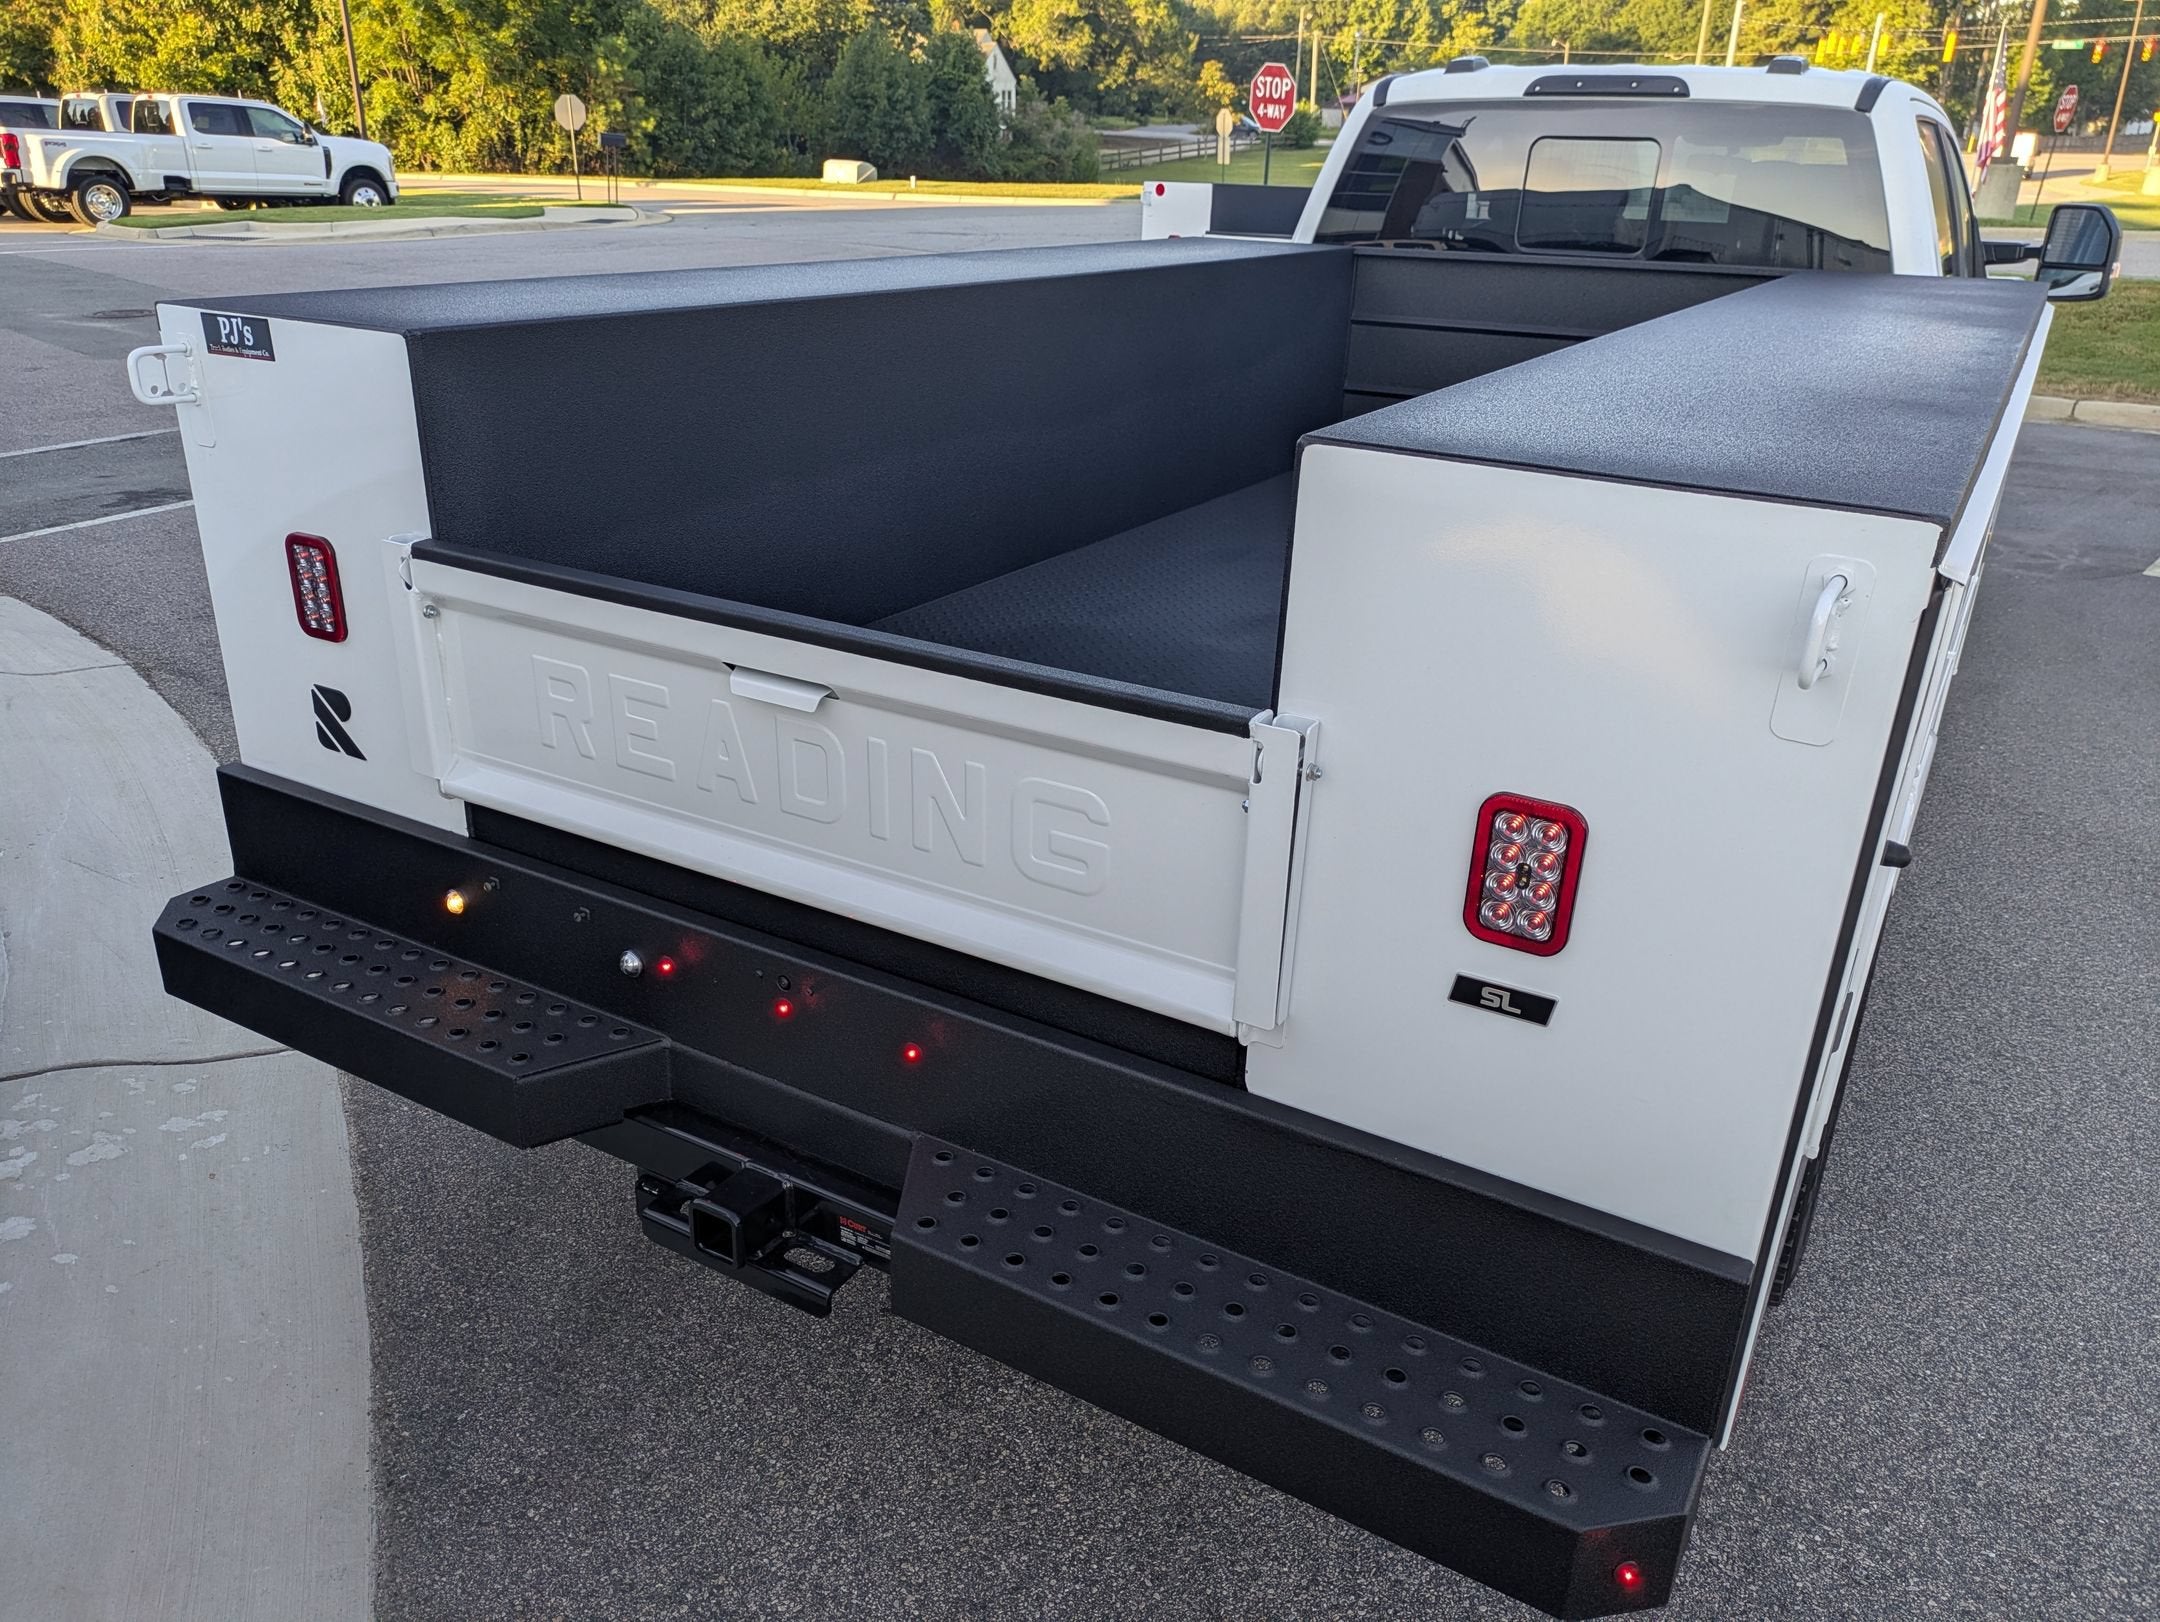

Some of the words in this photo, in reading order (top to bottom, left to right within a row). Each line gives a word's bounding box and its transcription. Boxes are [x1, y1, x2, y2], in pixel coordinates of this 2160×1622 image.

[1255, 75, 1291, 100] STOP
[1257, 102, 1287, 120] 4-WAY
[216, 316, 254, 346] PJ's
[531, 654, 1112, 898] READING
[1480, 986, 1522, 1015] SL
